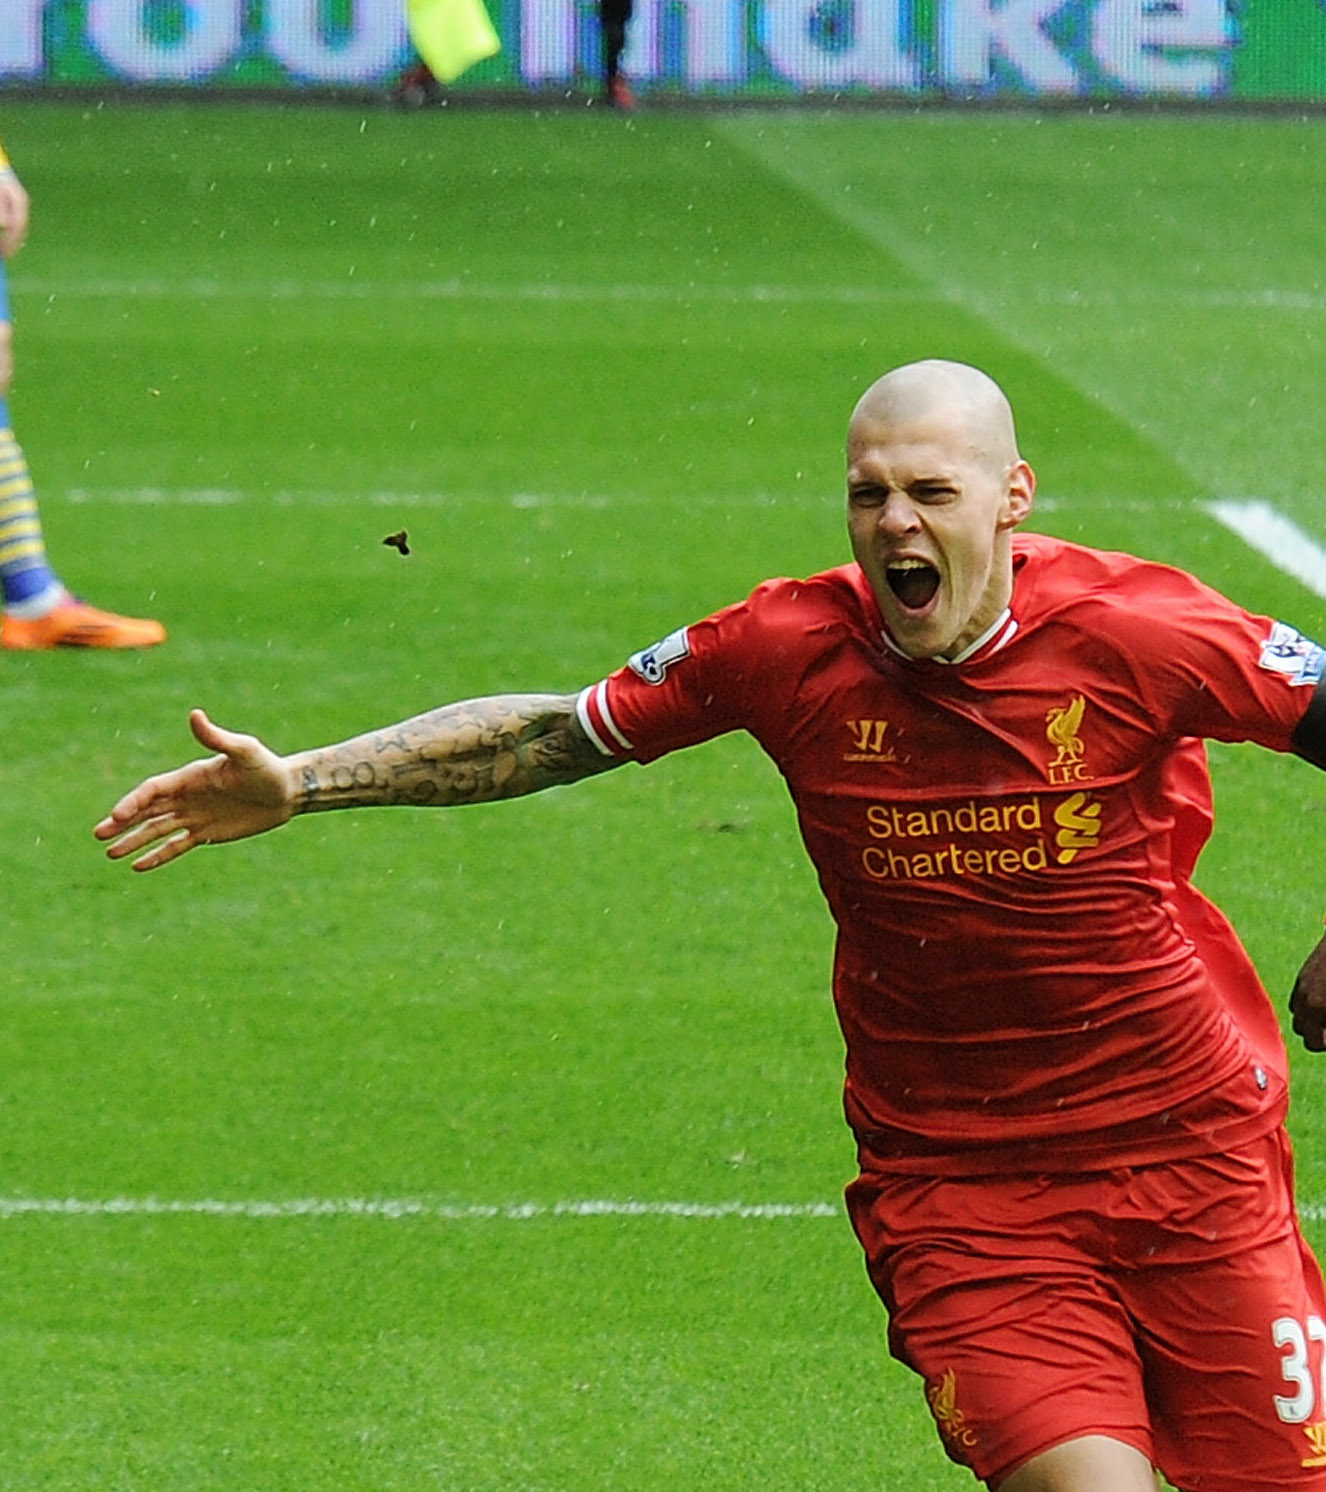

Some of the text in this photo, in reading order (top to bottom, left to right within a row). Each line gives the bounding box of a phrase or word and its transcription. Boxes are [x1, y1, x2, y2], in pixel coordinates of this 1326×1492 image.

[0, 0, 408, 82] ou
[866, 797, 1043, 839] Standard
[861, 839, 1048, 879] Chartered
